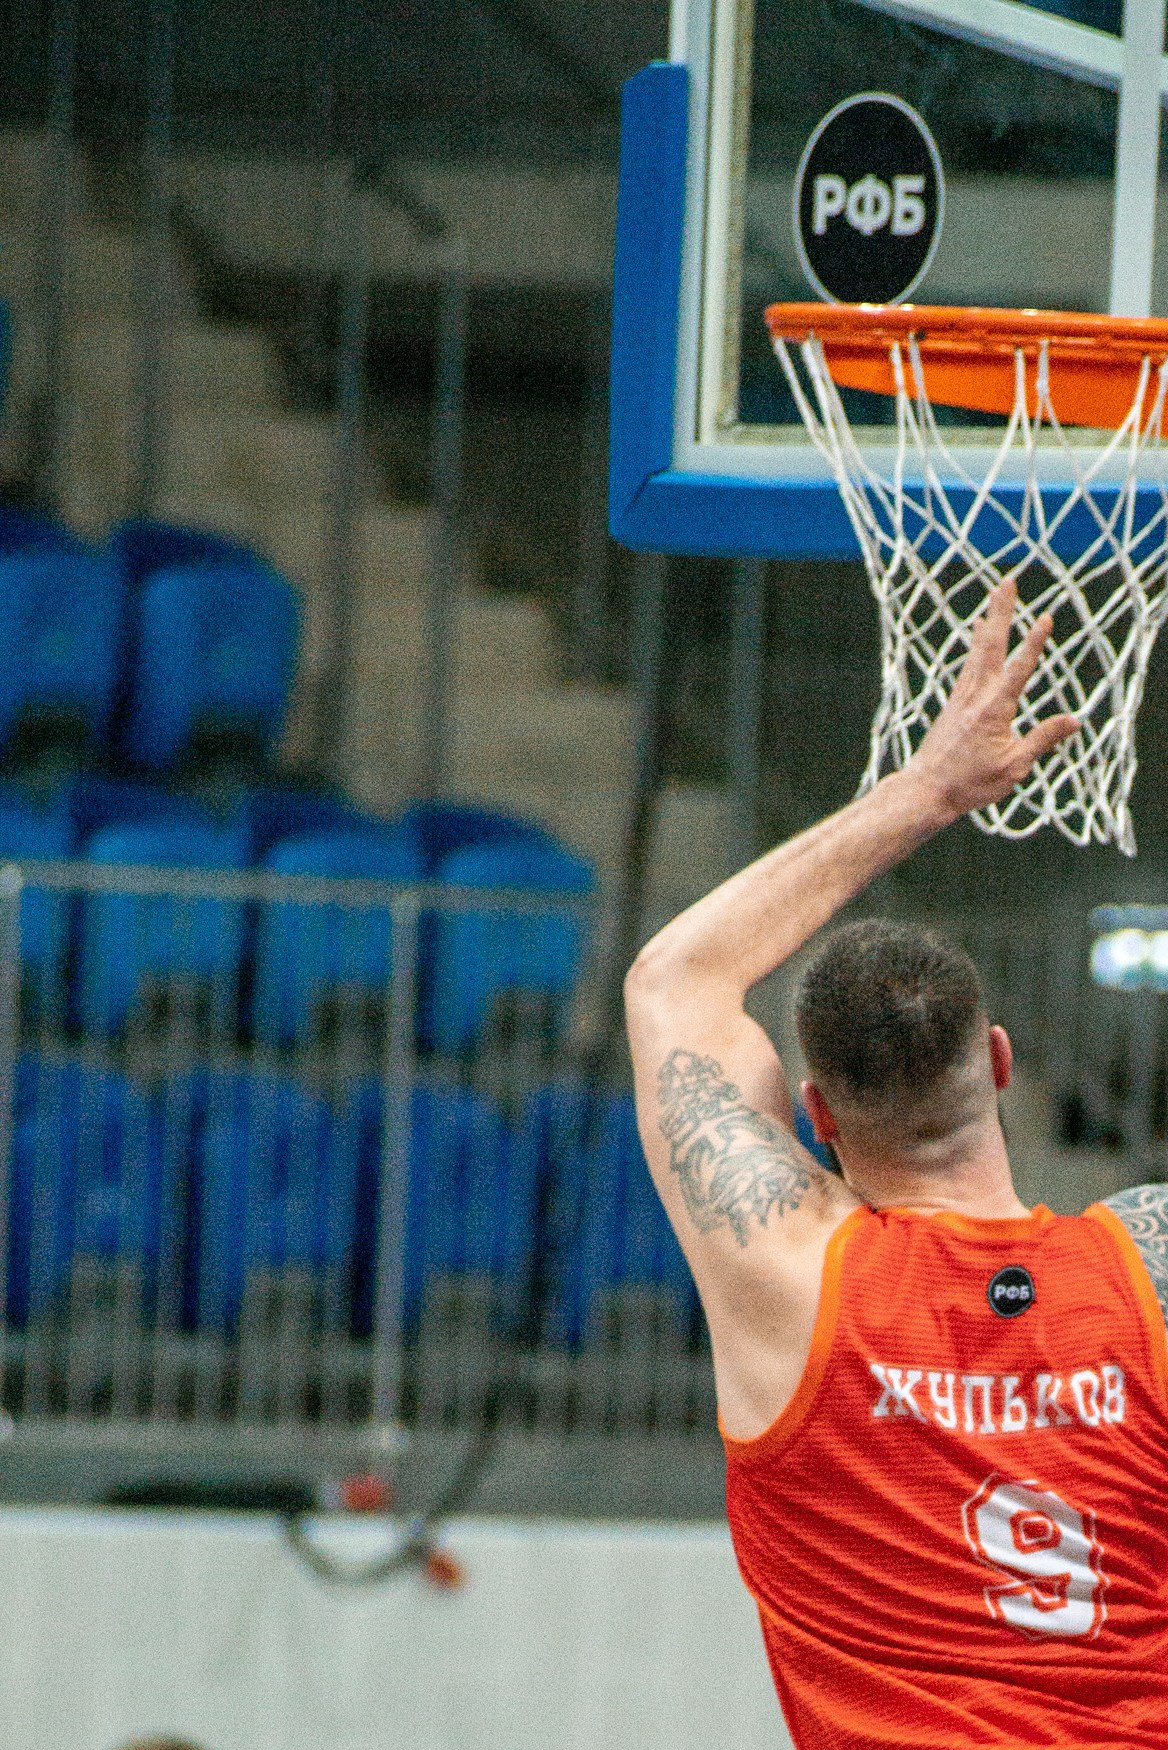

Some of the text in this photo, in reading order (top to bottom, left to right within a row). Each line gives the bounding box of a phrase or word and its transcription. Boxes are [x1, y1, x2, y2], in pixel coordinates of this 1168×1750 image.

[812, 174, 926, 236] РФБ
[994, 1284, 1029, 1300] РФБ
[961, 1472, 1110, 1641] 9
